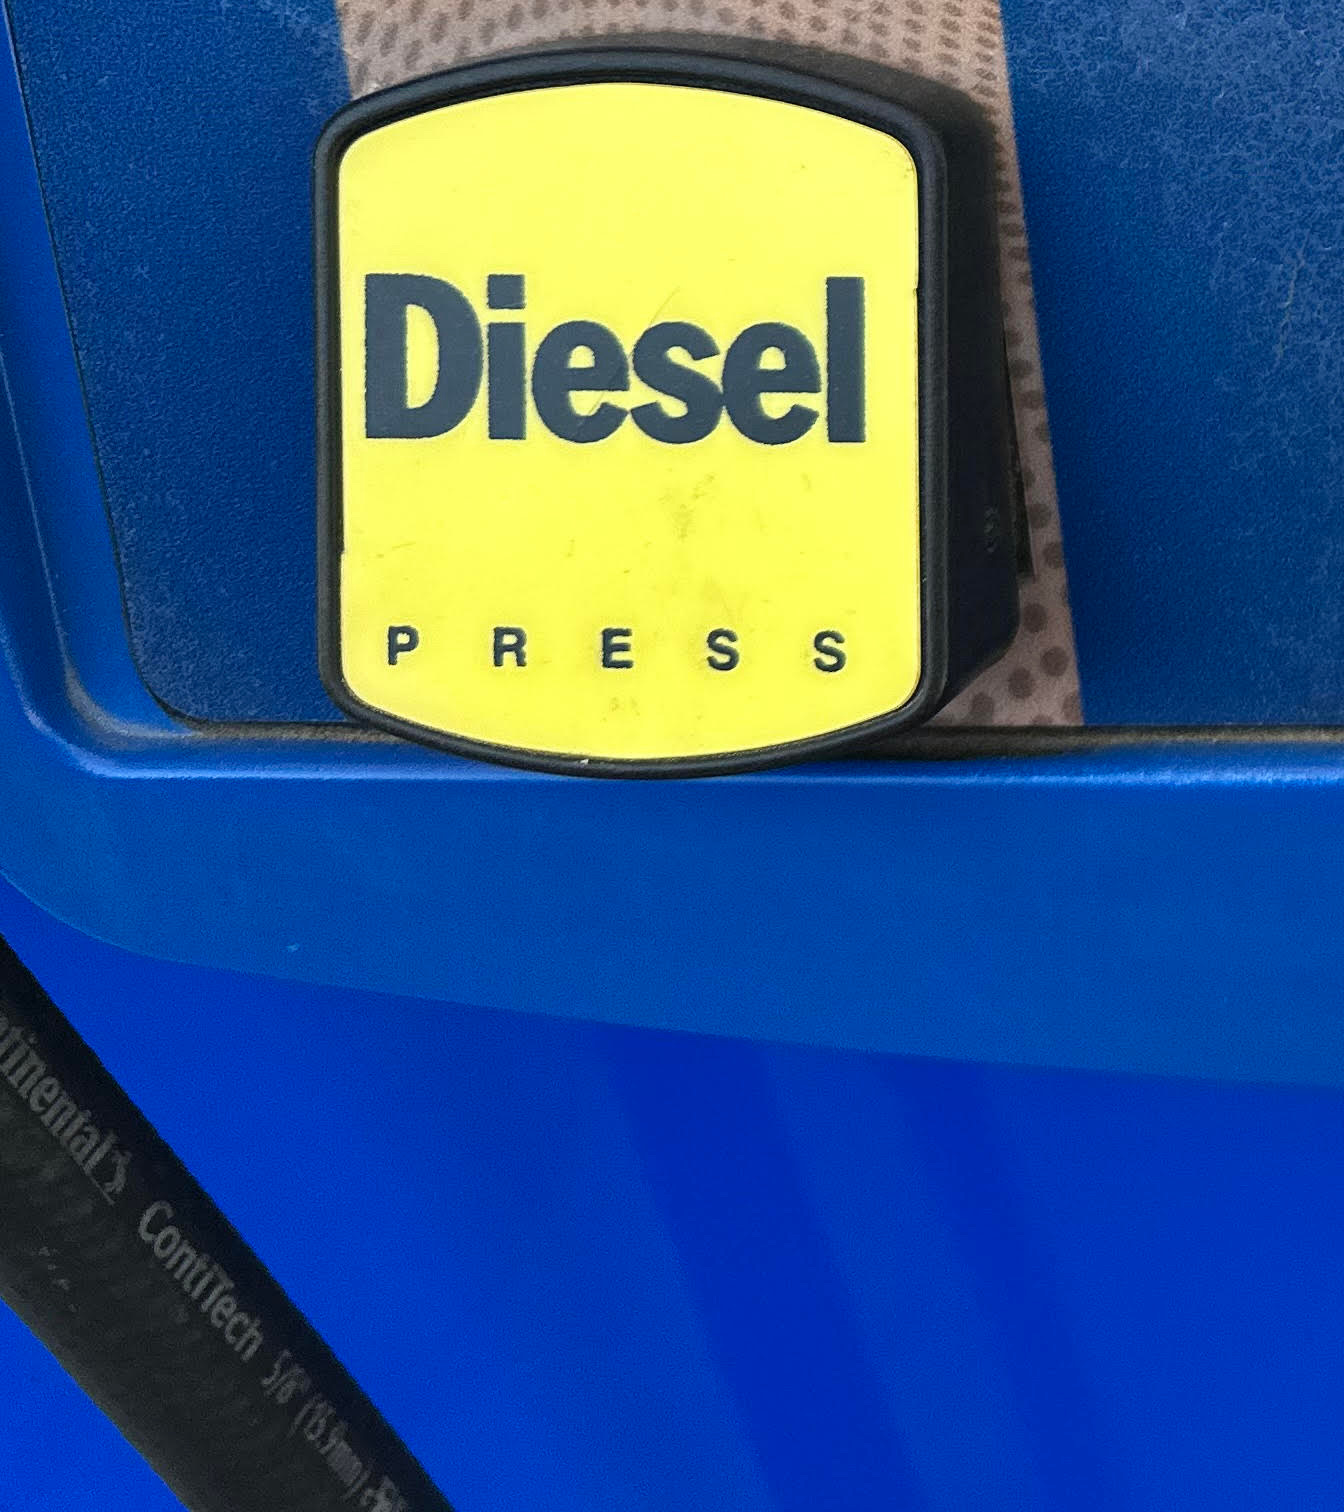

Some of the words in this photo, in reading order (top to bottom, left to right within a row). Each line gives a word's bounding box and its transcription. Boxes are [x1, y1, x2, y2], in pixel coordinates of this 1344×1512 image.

[364, 272, 867, 447] Diesel
[0, 1015, 117, 1178] tinental
[138, 1199, 264, 1362] ContiTech
